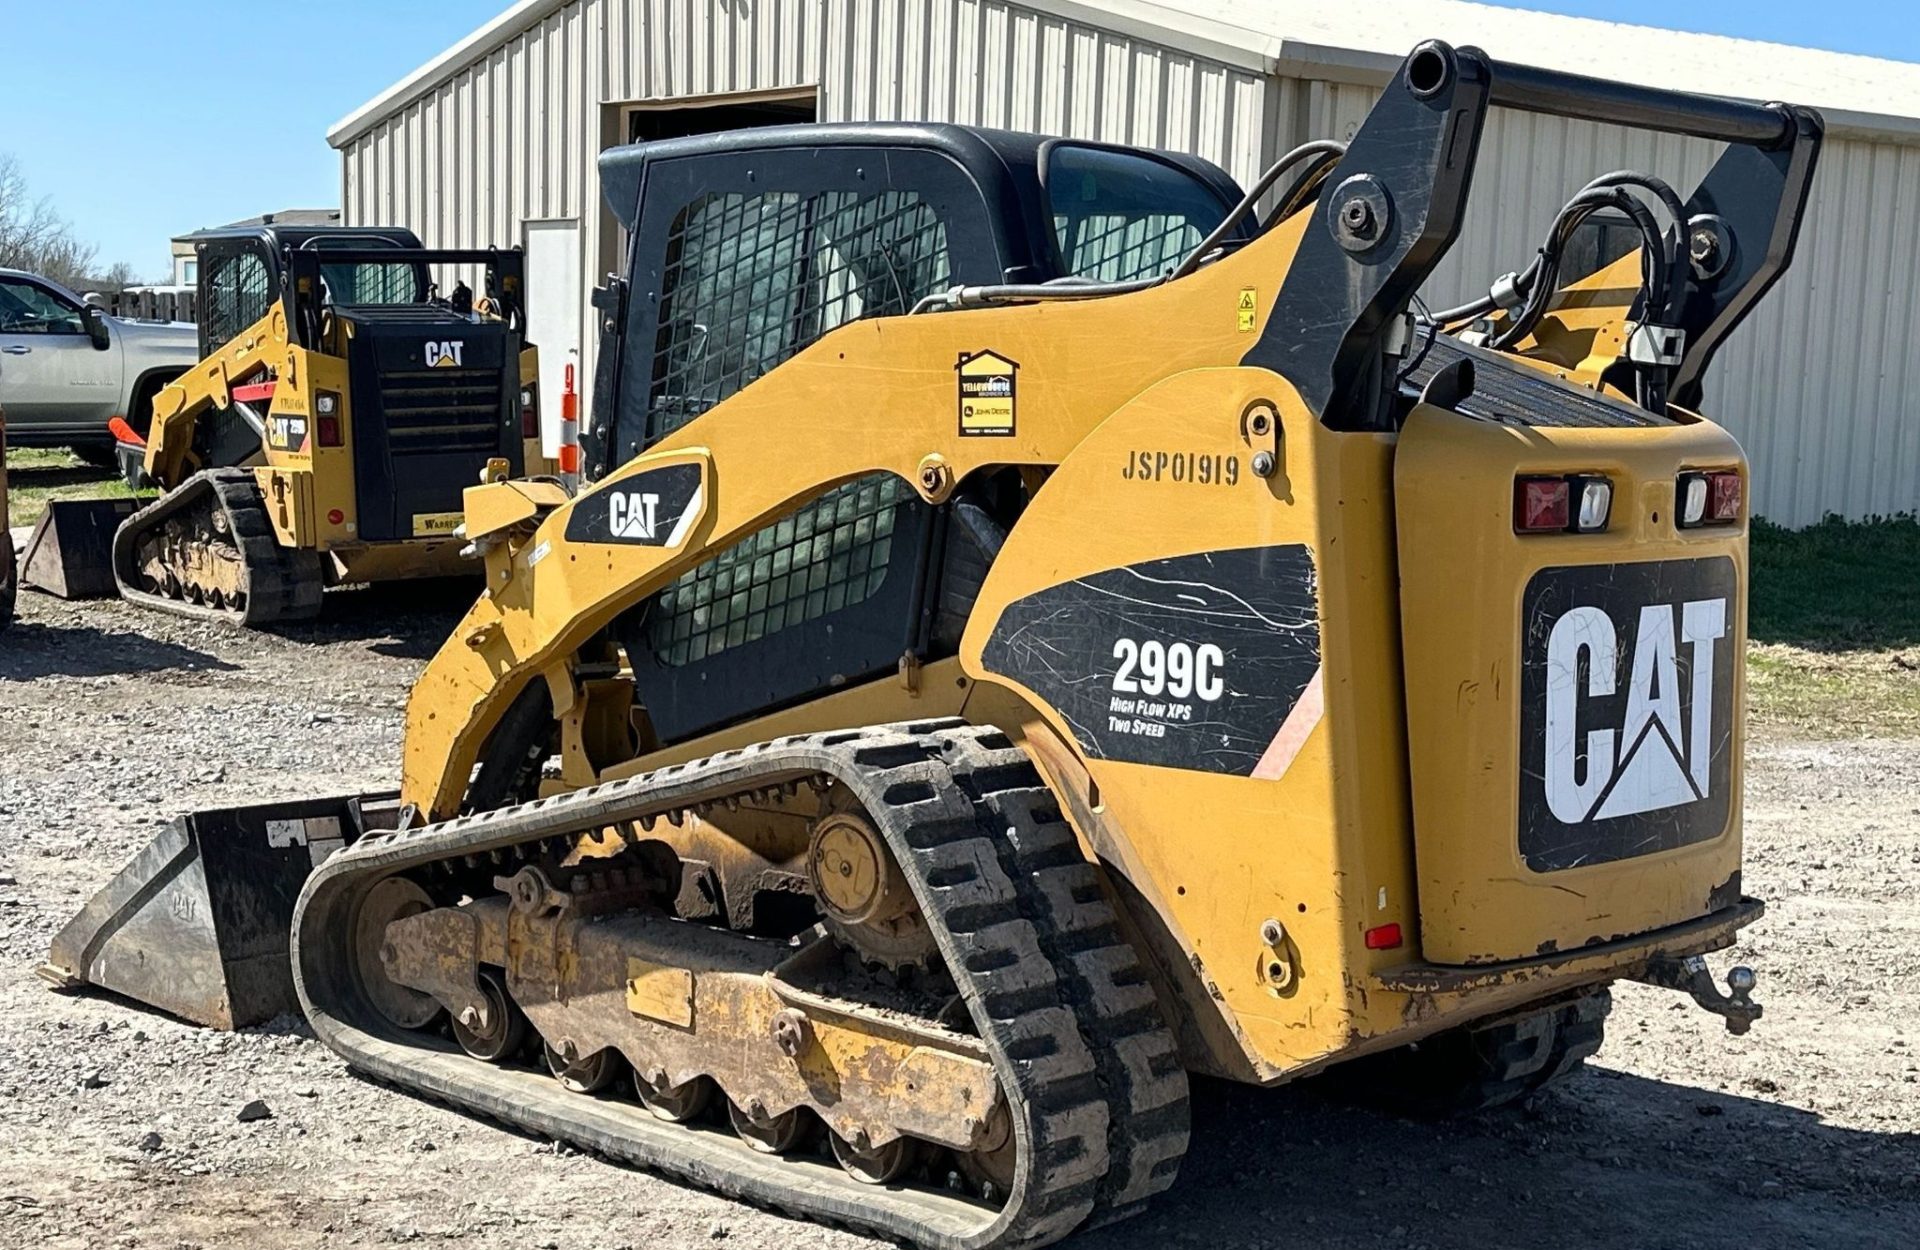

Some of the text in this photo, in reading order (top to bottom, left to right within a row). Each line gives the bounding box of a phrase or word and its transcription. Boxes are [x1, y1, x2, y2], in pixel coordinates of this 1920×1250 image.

[424, 340, 464, 368] CAT
[1122, 450, 1240, 487] JSP01919
[609, 490, 660, 539] CAT
[1112, 637, 1224, 702] 299C
[1108, 715, 1166, 738] TWO SPEED
[1109, 696, 1193, 721] HIGH FLOW XPS
[1544, 597, 1727, 825] CAT
